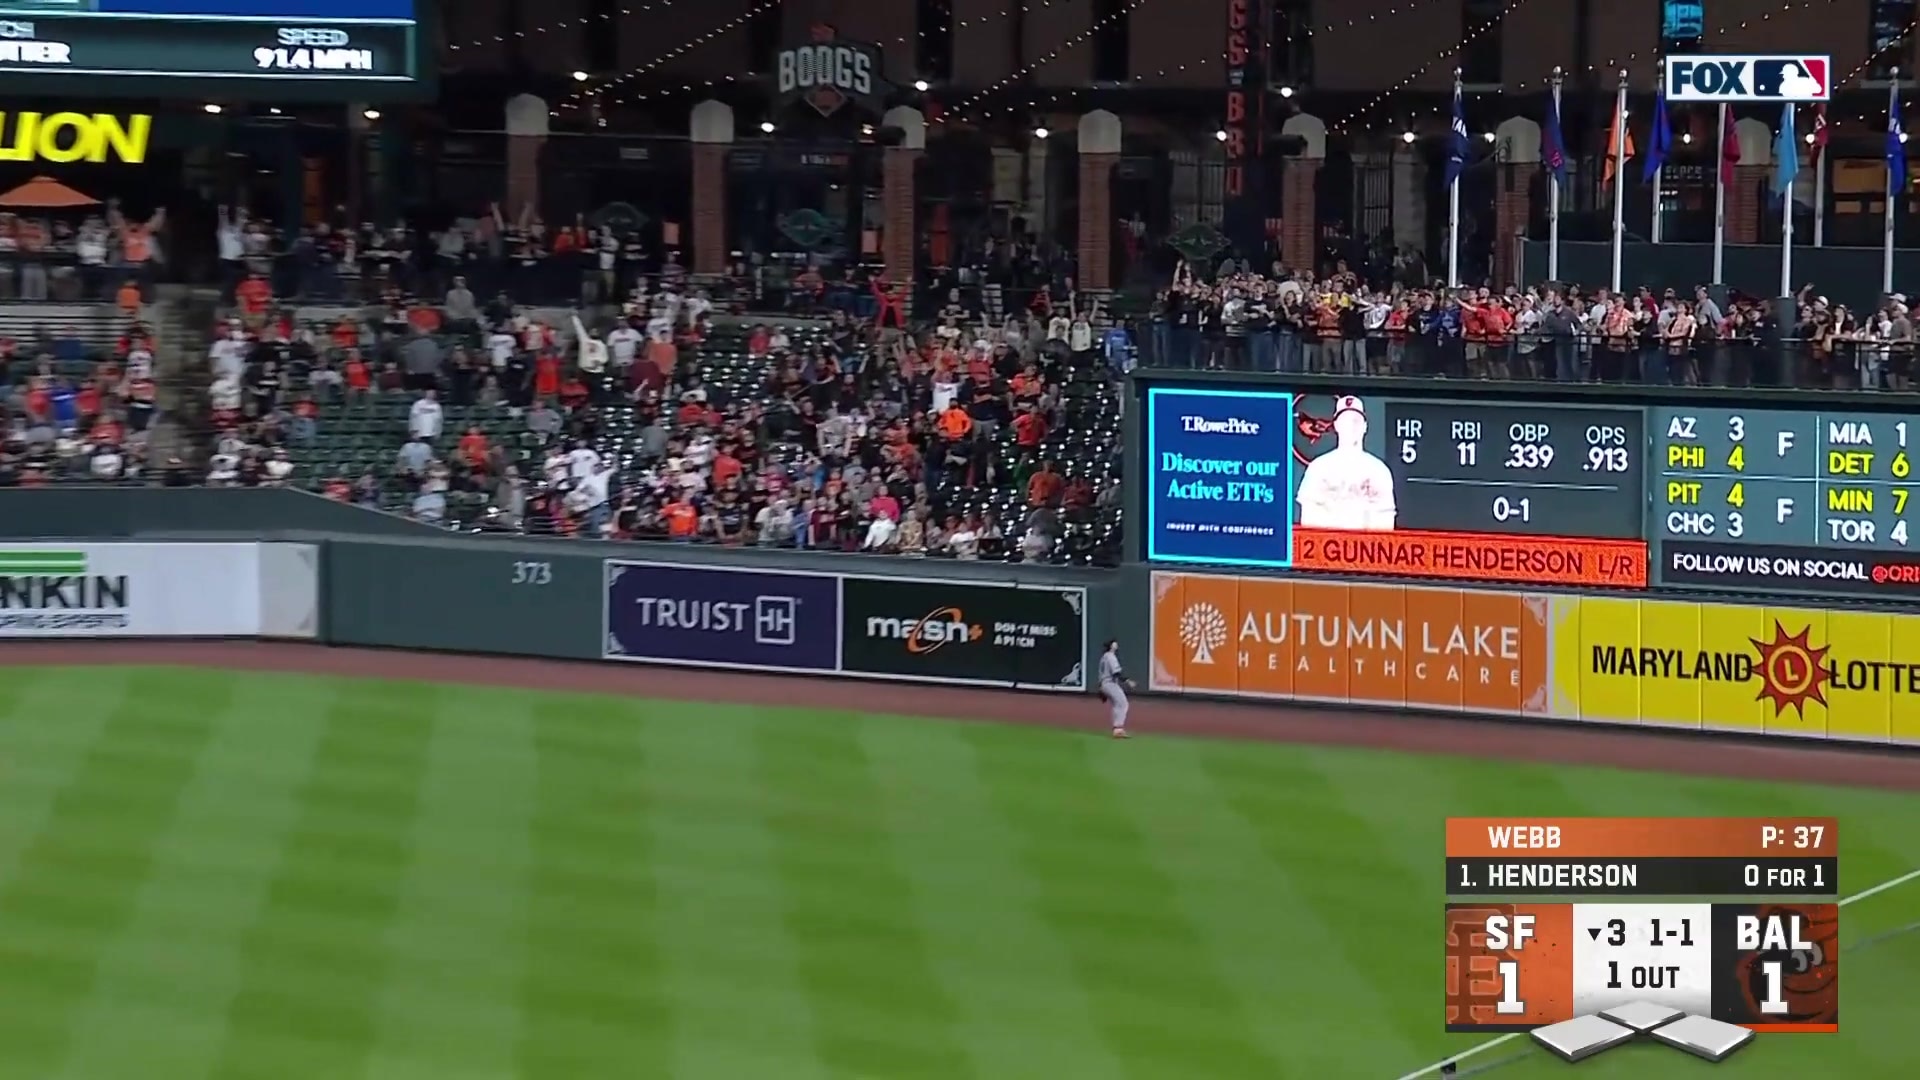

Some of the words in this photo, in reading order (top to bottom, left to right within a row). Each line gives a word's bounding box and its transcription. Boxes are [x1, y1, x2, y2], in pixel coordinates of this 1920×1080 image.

[278, 27, 349, 46] SPEED
[313, 48, 373, 70] MPH
[779, 45, 871, 95] BOOGS
[1396, 419, 1423, 437] HR
[1451, 421, 1482, 440] RBI
[1509, 423, 1550, 442] OBP
[1586, 425, 1626, 445] OPS
[1667, 416, 1698, 438] AZ
[1728, 416, 1745, 442] 3
[1829, 422, 1873, 446] MIA
[1895, 422, 1907, 448] 1
[1401, 440, 1417, 464] 5
[1456, 442, 1477, 466] 11
[1504, 444, 1555, 469] .339
[1583, 447, 1629, 472] .913
[1777, 431, 1795, 457] F
[1161, 452, 1242, 475] Discover
[1245, 461, 1280, 476] our
[1668, 446, 1705, 468] PHI
[1727, 445, 1745, 471] 4
[1829, 452, 1875, 475] DET
[1891, 451, 1910, 478] 6
[1167, 478, 1224, 501] Active
[1227, 481, 1275, 503] ETFs
[1667, 482, 1702, 504] PIT
[1726, 482, 1744, 508] 4
[1828, 488, 1873, 512] MIN
[1892, 489, 1909, 515] 7
[1493, 496, 1531, 522] 0-1
[1777, 498, 1794, 524] F
[1667, 511, 1715, 535] CHC
[1727, 511, 1743, 538] 3
[1827, 519, 1876, 543] TOR
[1889, 518, 1909, 546] 4
[1303, 540, 1316, 560] 2
[1323, 539, 1426, 567] GUNNAR
[1432, 544, 1584, 574] HENDERSON
[1599, 553, 1634, 580] L/R
[1673, 553, 1744, 574] FOLLOW
[1747, 556, 1771, 575] US
[1773, 558, 1801, 577] ON
[1803, 560, 1869, 580] SOCIAL
[512, 562, 552, 585] 373
[636, 597, 750, 632] TRUIST
[1238, 611, 1404, 651] AUTUMN
[1422, 621, 1520, 660] LAKE
[1238, 651, 1521, 687] HEALTHCARE
[1592, 645, 1752, 683] MARYLAND
[1830, 658, 1920, 694] LOTTE
